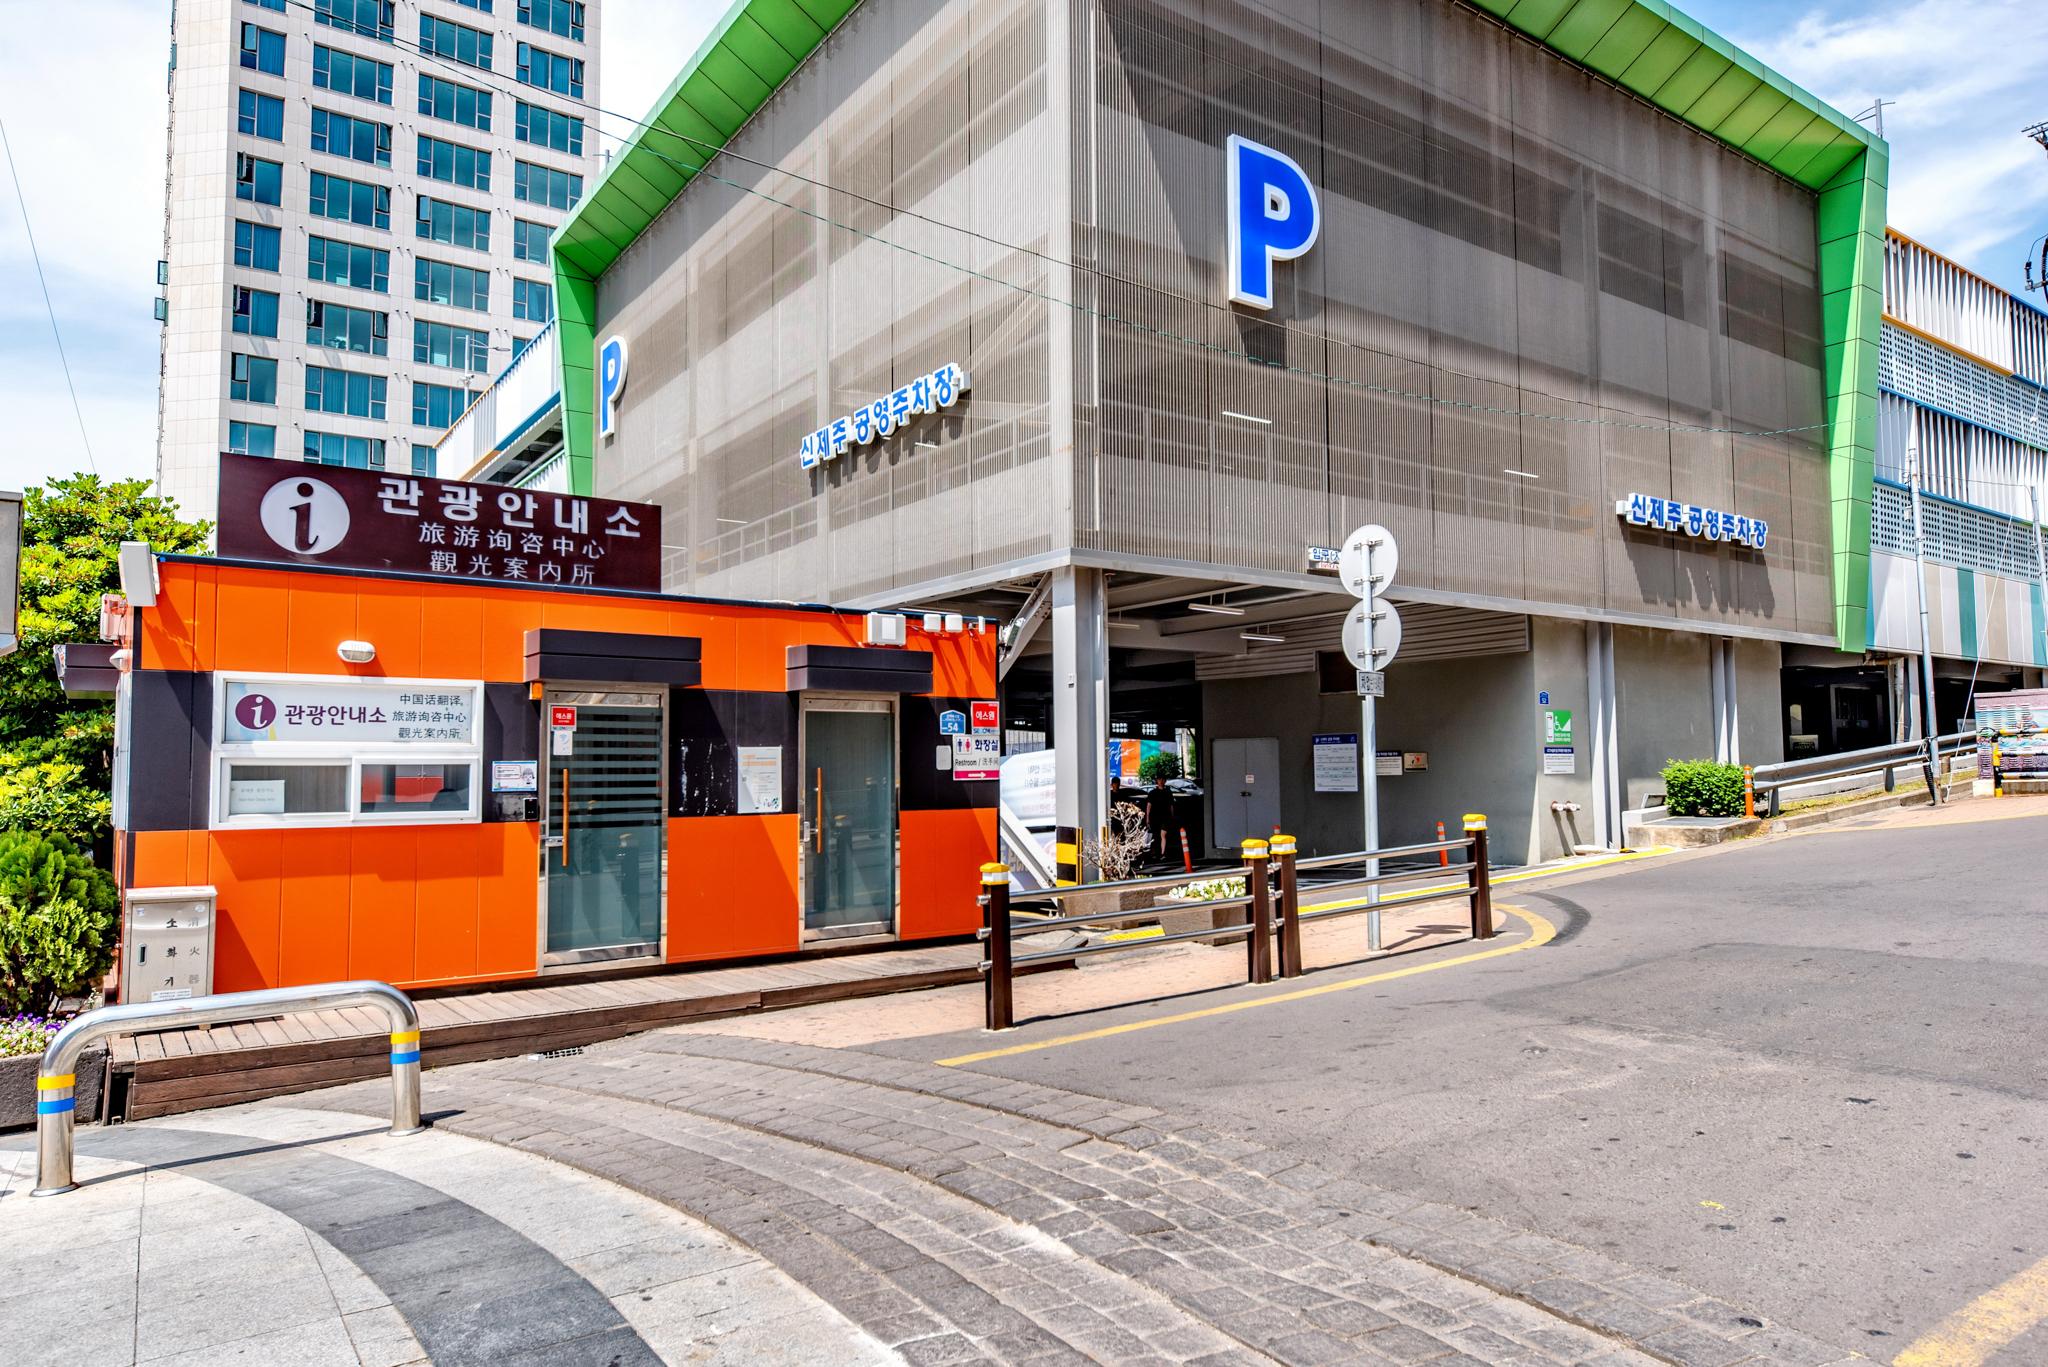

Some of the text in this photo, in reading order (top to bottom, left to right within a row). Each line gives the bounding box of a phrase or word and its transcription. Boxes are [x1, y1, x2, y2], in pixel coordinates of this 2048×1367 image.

[1227, 133, 1320, 311] P
[600, 335, 629, 439] P
[800, 363, 960, 469] 신제주 공영주차장
[376, 477, 642, 539] 관광안내소
[1627, 493, 1769, 549] 신제주 공영주차장
[418, 521, 605, 561] 旅游询咨中心
[284, 704, 388, 727] 관광안내소
[392, 710, 467, 723] 旅游询咨中心
[399, 693, 463, 706] 中国话翻译
[954, 758, 977, 767] Restroom
[974, 739, 998, 752] 화장실
[164, 917, 178, 988] 소화기
